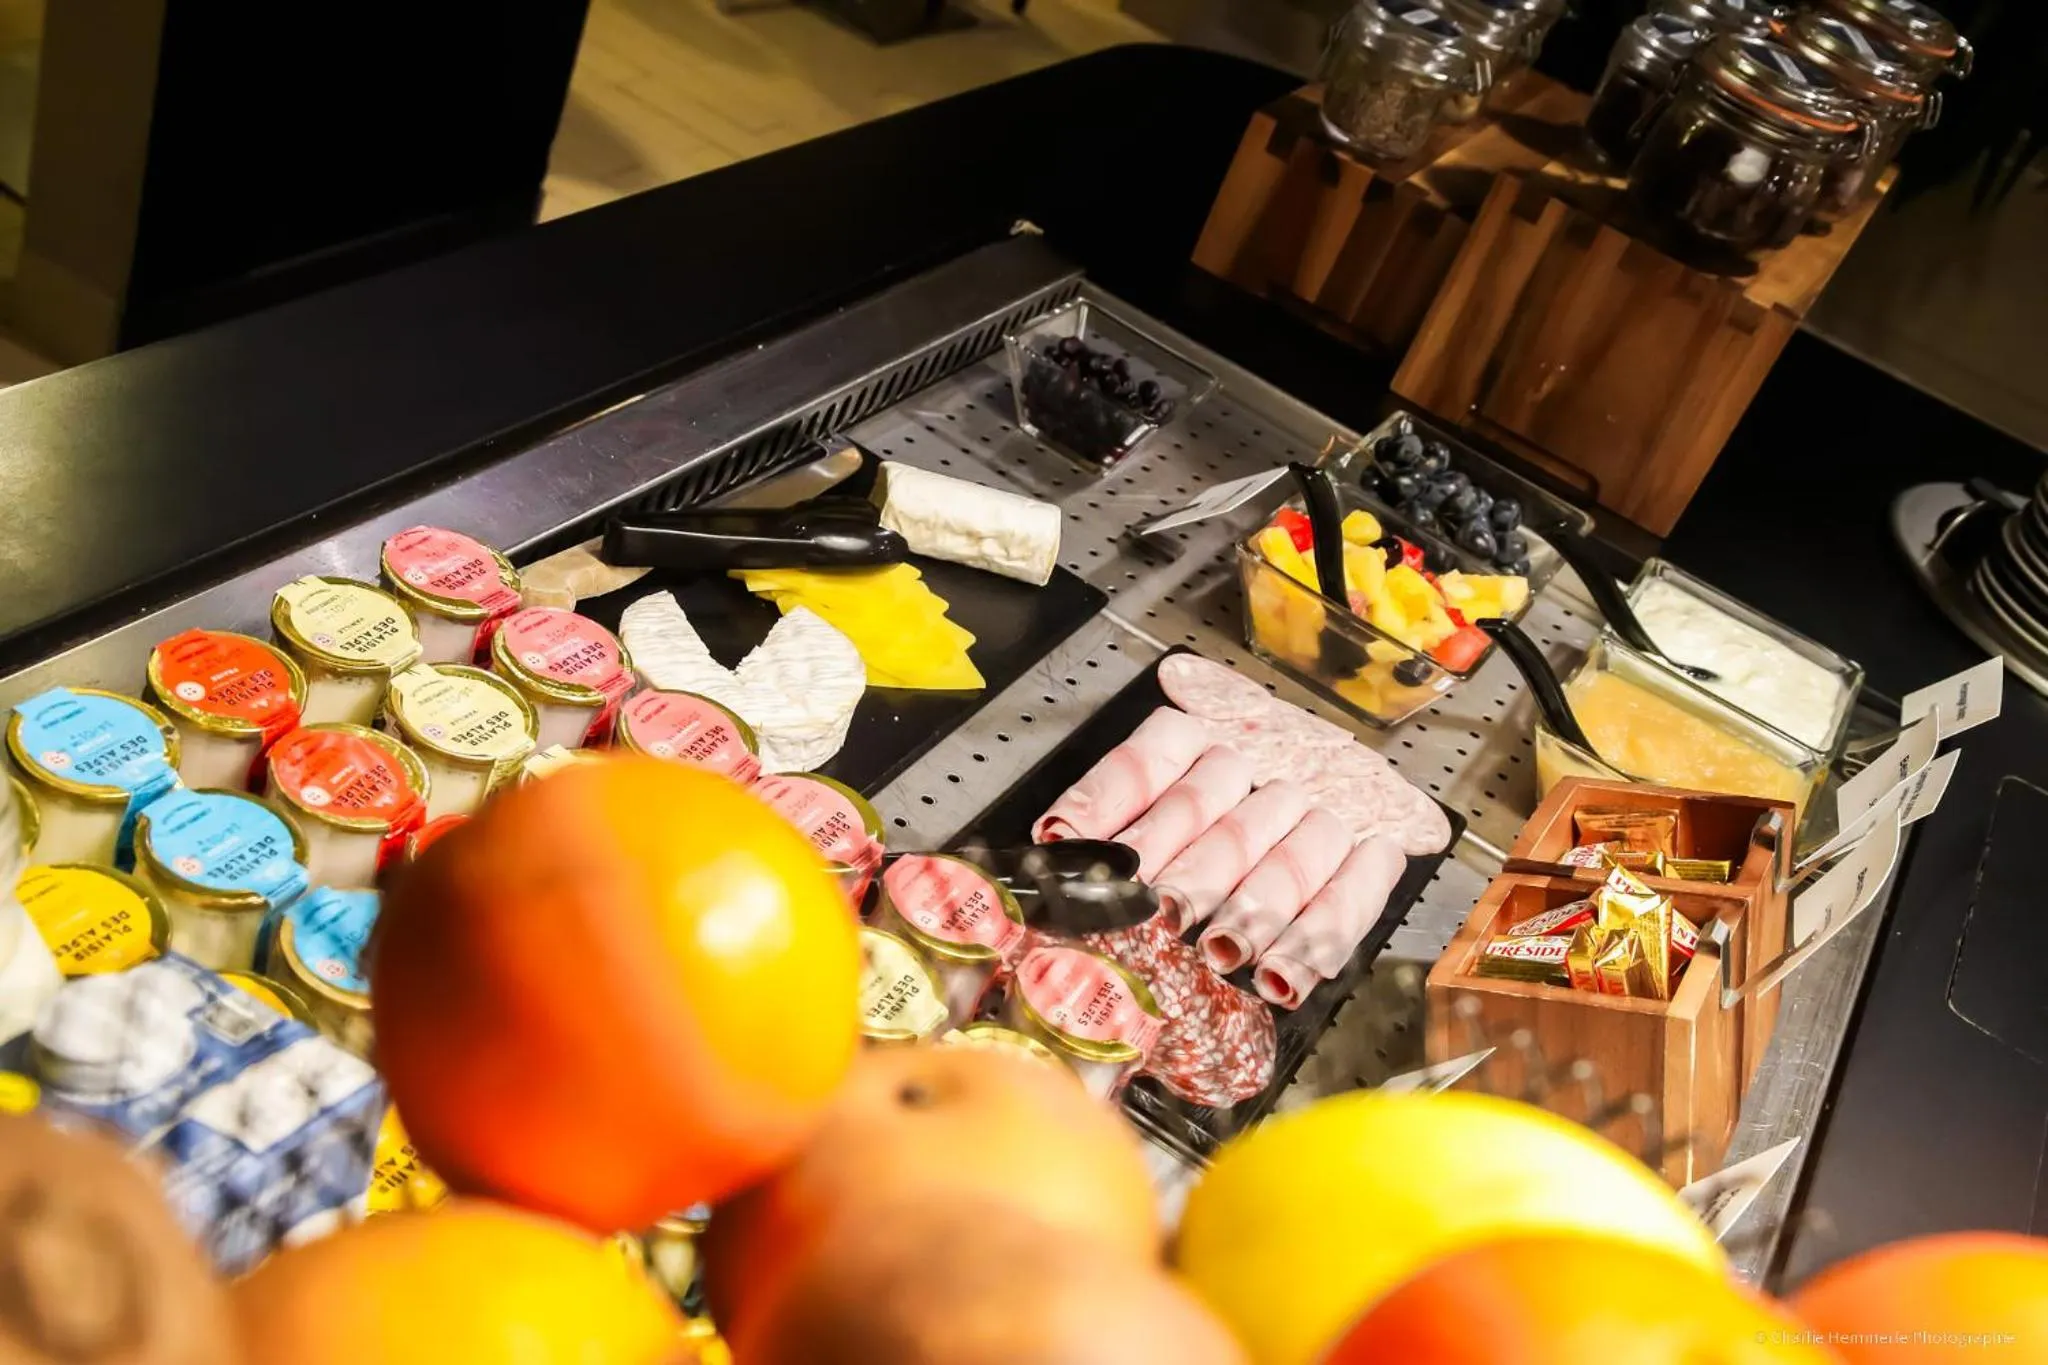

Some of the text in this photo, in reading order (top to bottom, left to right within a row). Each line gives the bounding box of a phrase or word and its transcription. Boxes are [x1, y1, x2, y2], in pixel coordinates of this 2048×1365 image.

[430, 558, 484, 588] DES ALPES
[446, 568, 487, 591] PLAISIR
[339, 616, 396, 651] DES ALPES
[357, 627, 399, 653] PLAISIR
[548, 642, 604, 672] DES ALPES
[564, 651, 606, 675] PLAISIR
[208, 670, 274, 704] DES ALPES
[226, 681, 276, 706] PLAISIR
[451, 710, 509, 744] DES ALPES
[468, 721, 512, 746] PLAISIR
[705, 725, 724, 739] DES
[75, 735, 148, 773] DES ALPES
[694, 736, 729, 761] PLAISIR
[95, 748, 149, 776] PLAISIR
[365, 765, 388, 781] DES
[333, 781, 365, 808] ALPES
[351, 777, 392, 809] PLAISIR
[826, 811, 846, 828] DES
[249, 835, 276, 854] DES
[207, 853, 246, 878] ALPES
[227, 849, 279, 881] PLAISIR
[965, 891, 984, 908] DES
[893, 975, 914, 993] DES
[1078, 982, 1115, 1026] DES ALPES
[1094, 993, 1123, 1026] PLAISIR
